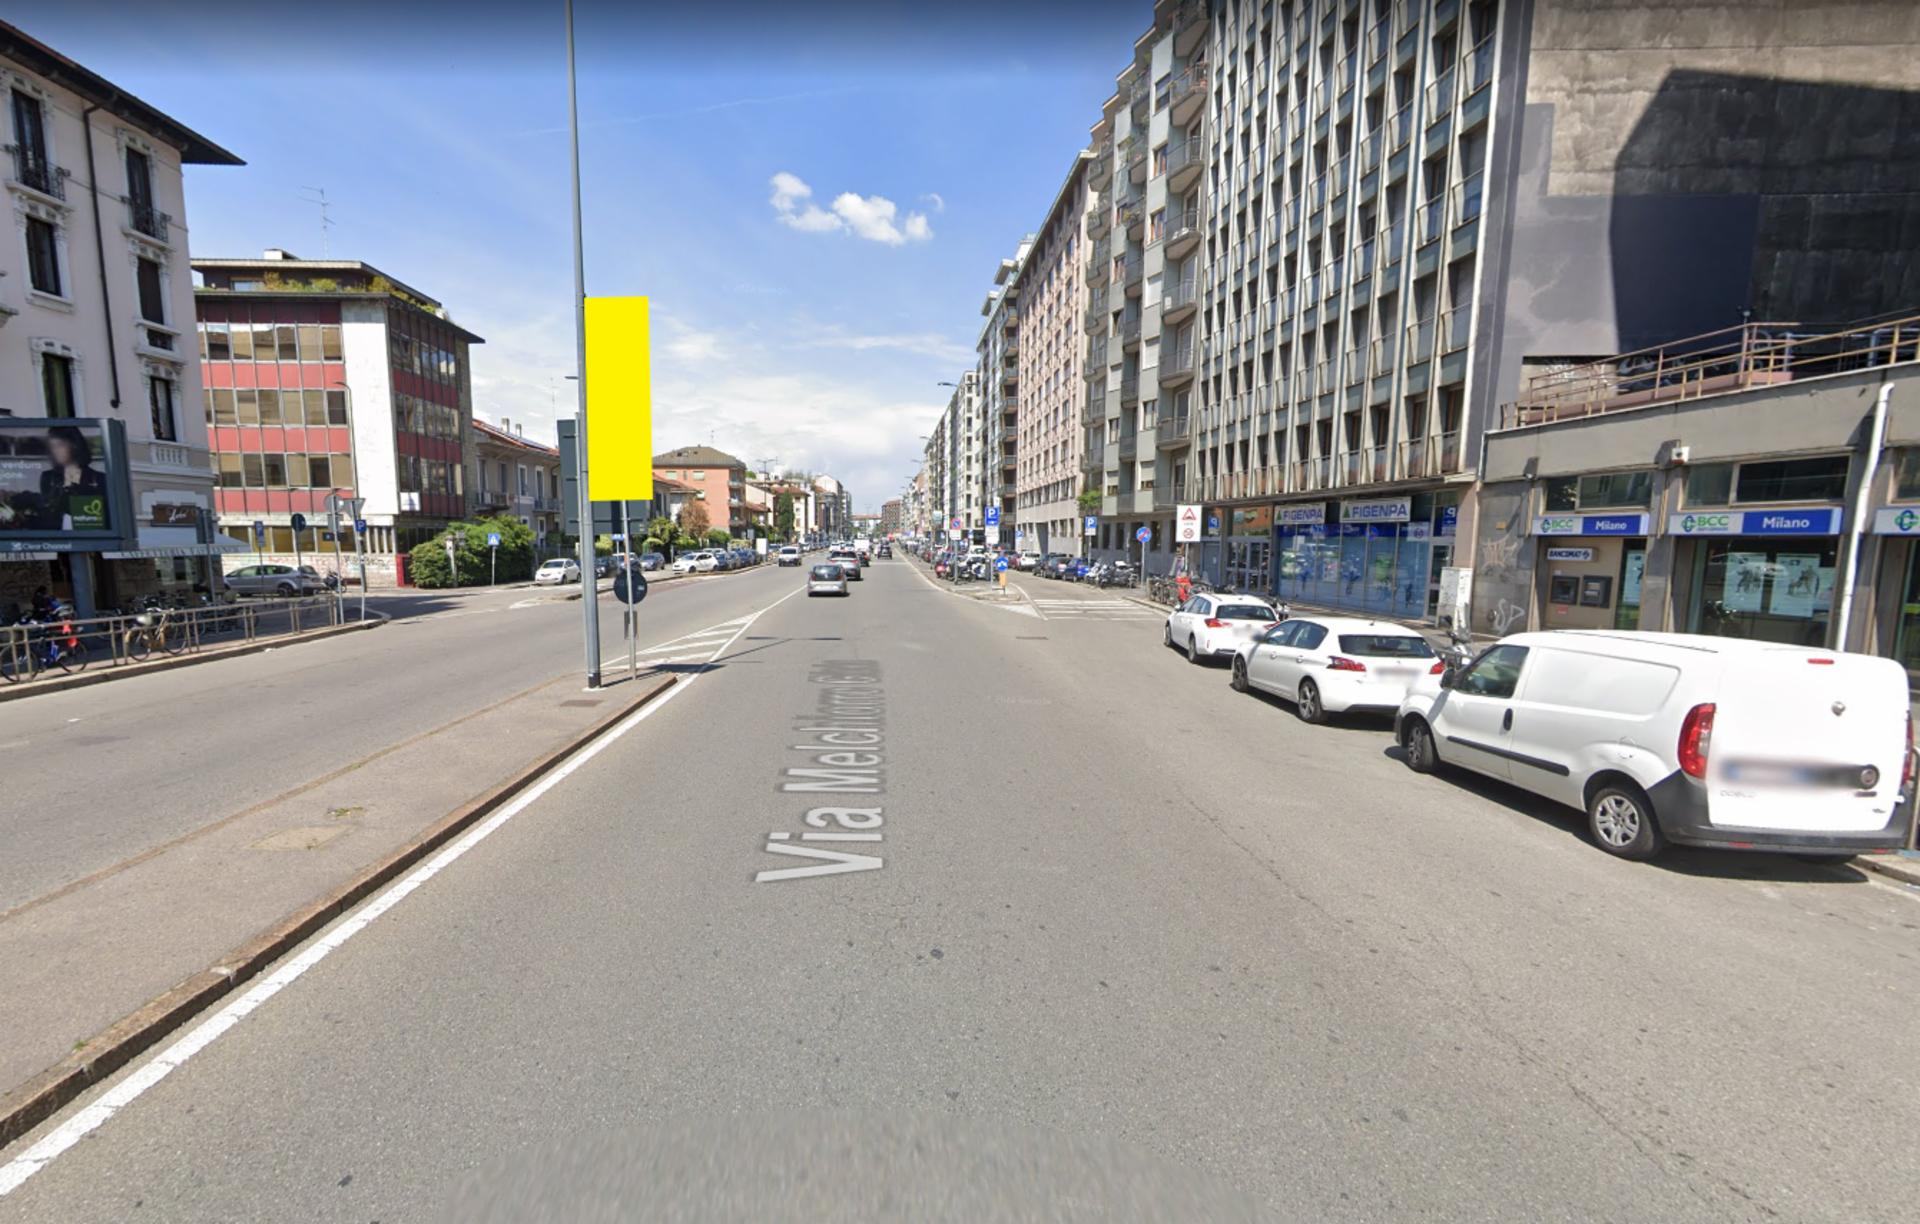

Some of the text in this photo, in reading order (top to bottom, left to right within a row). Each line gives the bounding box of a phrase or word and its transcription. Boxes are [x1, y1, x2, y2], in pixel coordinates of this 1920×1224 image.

[1283, 507, 1323, 521] FIGENPA
[1352, 503, 1409, 519] FIGENPA
[1552, 519, 1627, 531] BCC Milano
[1697, 515, 1810, 529] BCC Milano
[1549, 550, 1582, 558] BANCOMAT
